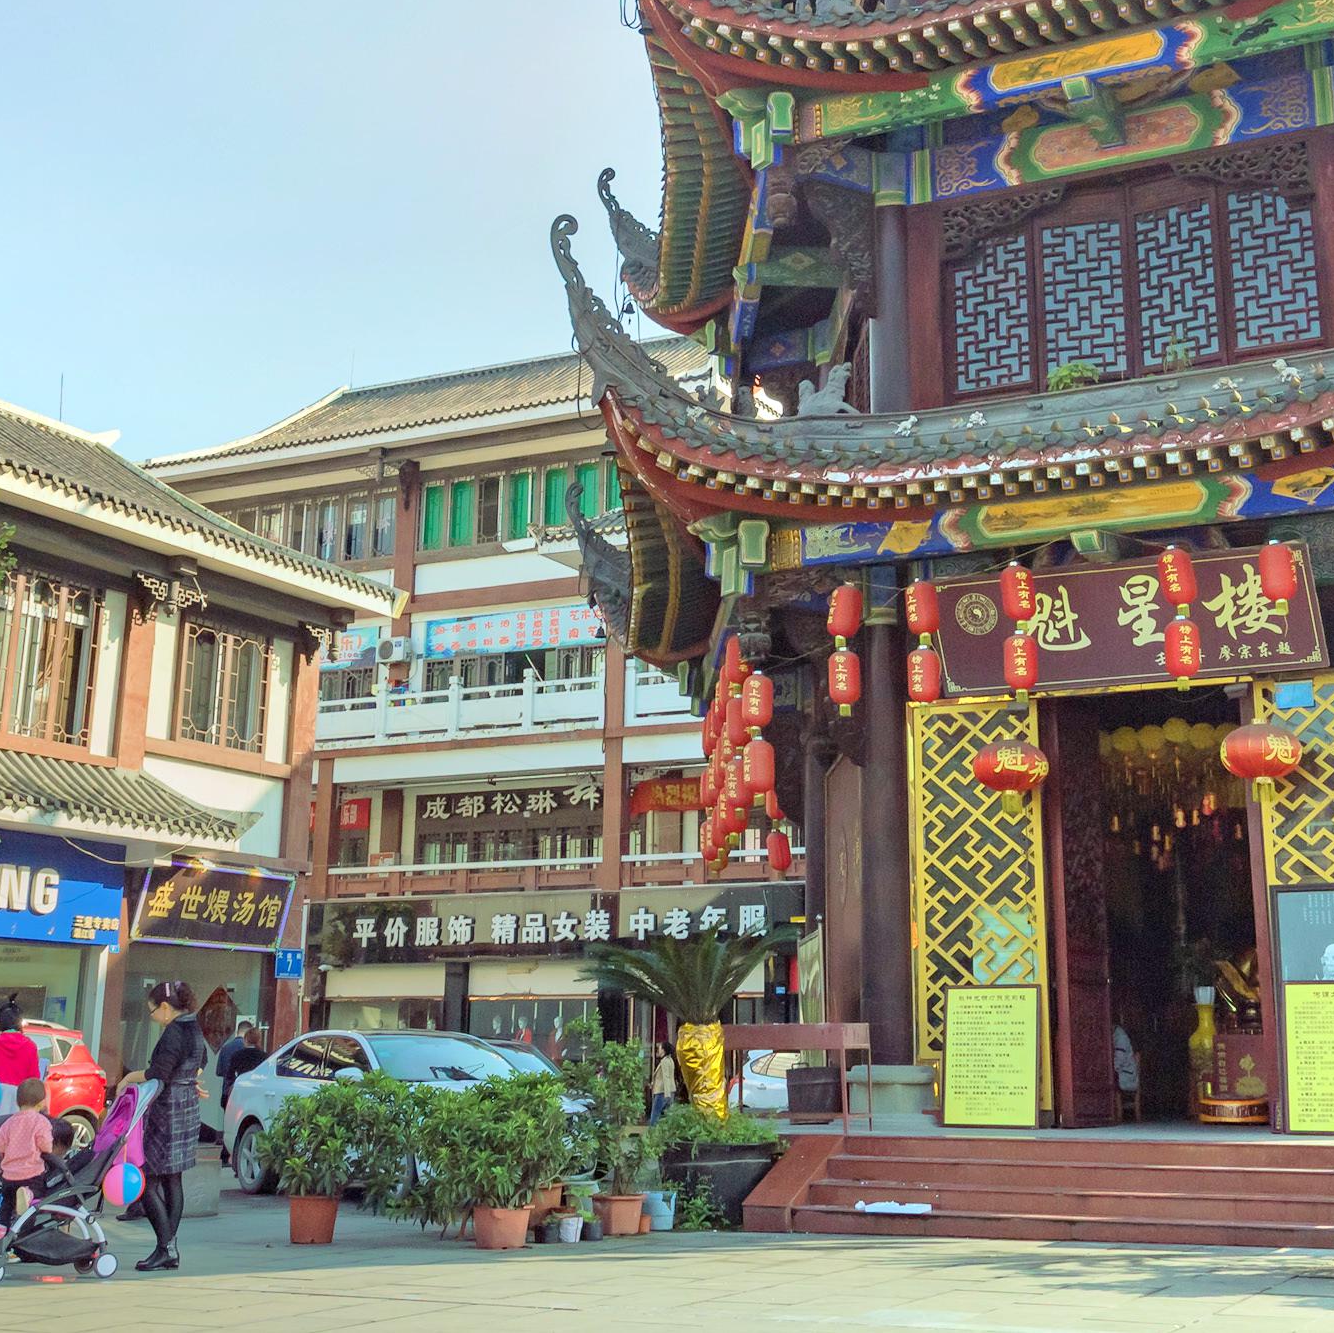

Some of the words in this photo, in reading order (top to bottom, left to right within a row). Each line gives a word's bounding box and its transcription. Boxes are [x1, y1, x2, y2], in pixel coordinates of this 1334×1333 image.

[1027, 563, 1284, 652] 魁星楼
[147, 880, 283, 929] 盛世煨汤馆
[352, 914, 476, 948] 平价服饰
[490, 910, 611, 944] 精品女装
[286, 959, 293, 972] 7
